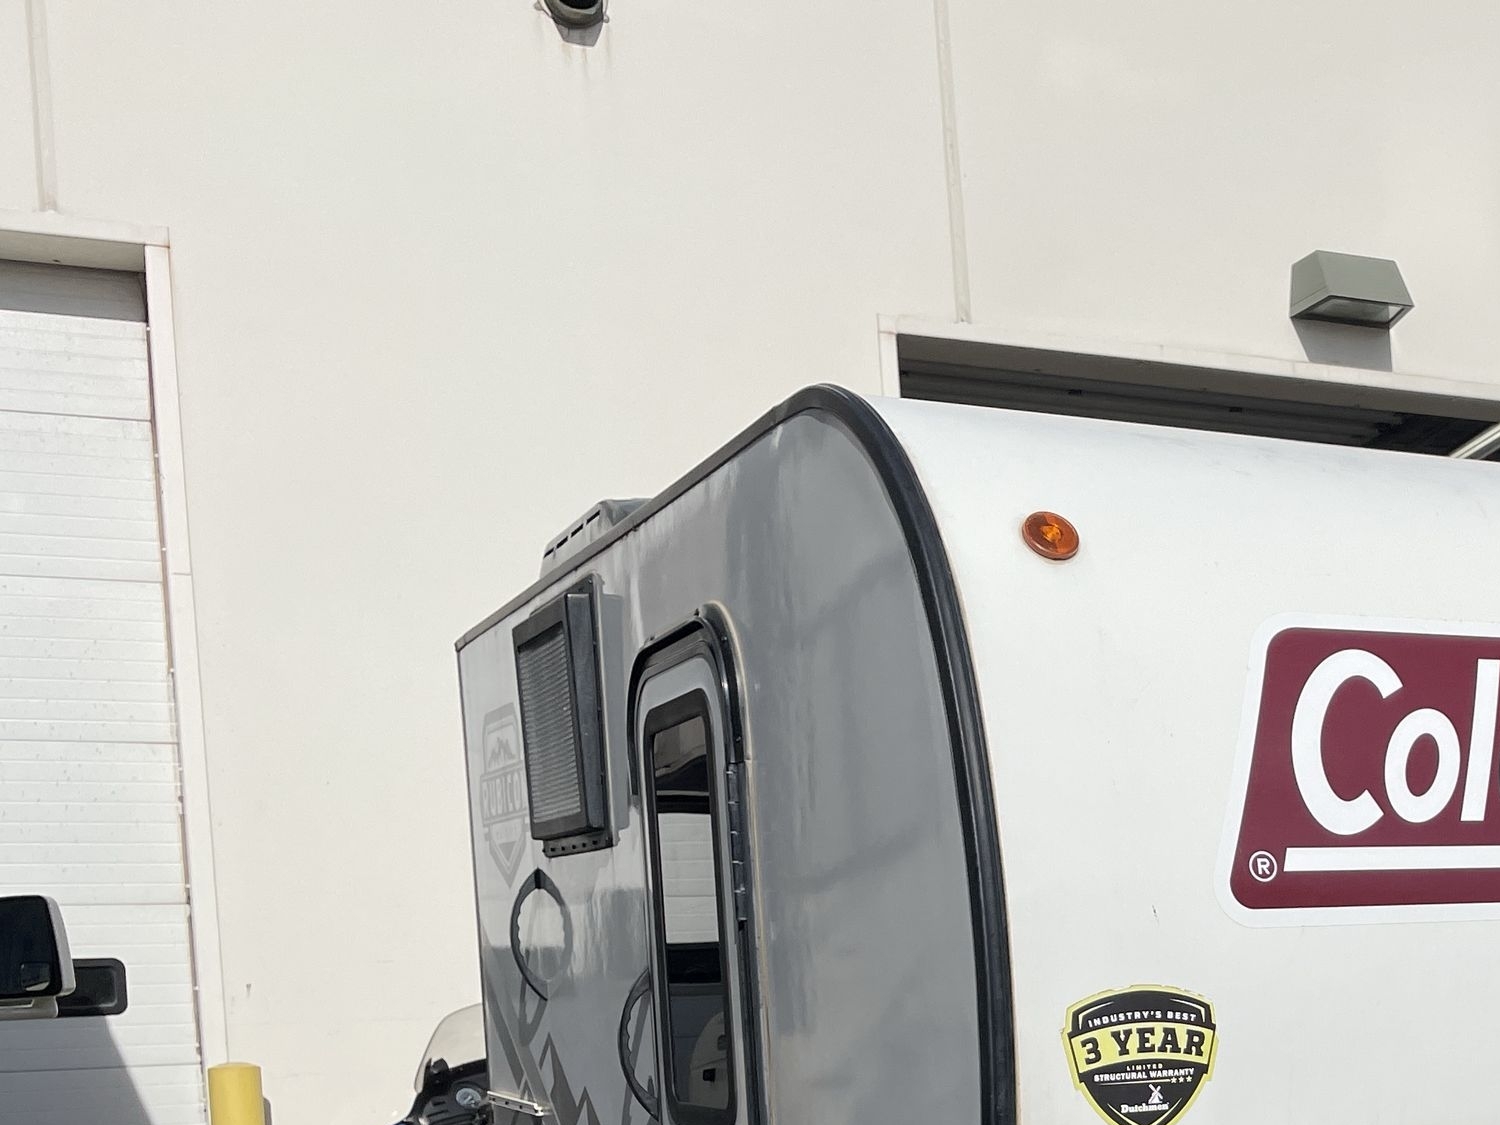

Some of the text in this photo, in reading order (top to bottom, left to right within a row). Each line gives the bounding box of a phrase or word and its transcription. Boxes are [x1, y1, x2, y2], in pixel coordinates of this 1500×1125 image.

[1088, 1010, 1197, 1028] INDUSTRY'S BEST
[1080, 1026, 1206, 1065] 3 YEAR
[1126, 1063, 1163, 1071] LIMITED
[1093, 1068, 1195, 1082] STRUCTURAL WARRANTY
[1120, 1101, 1169, 1113] Dutchmen
